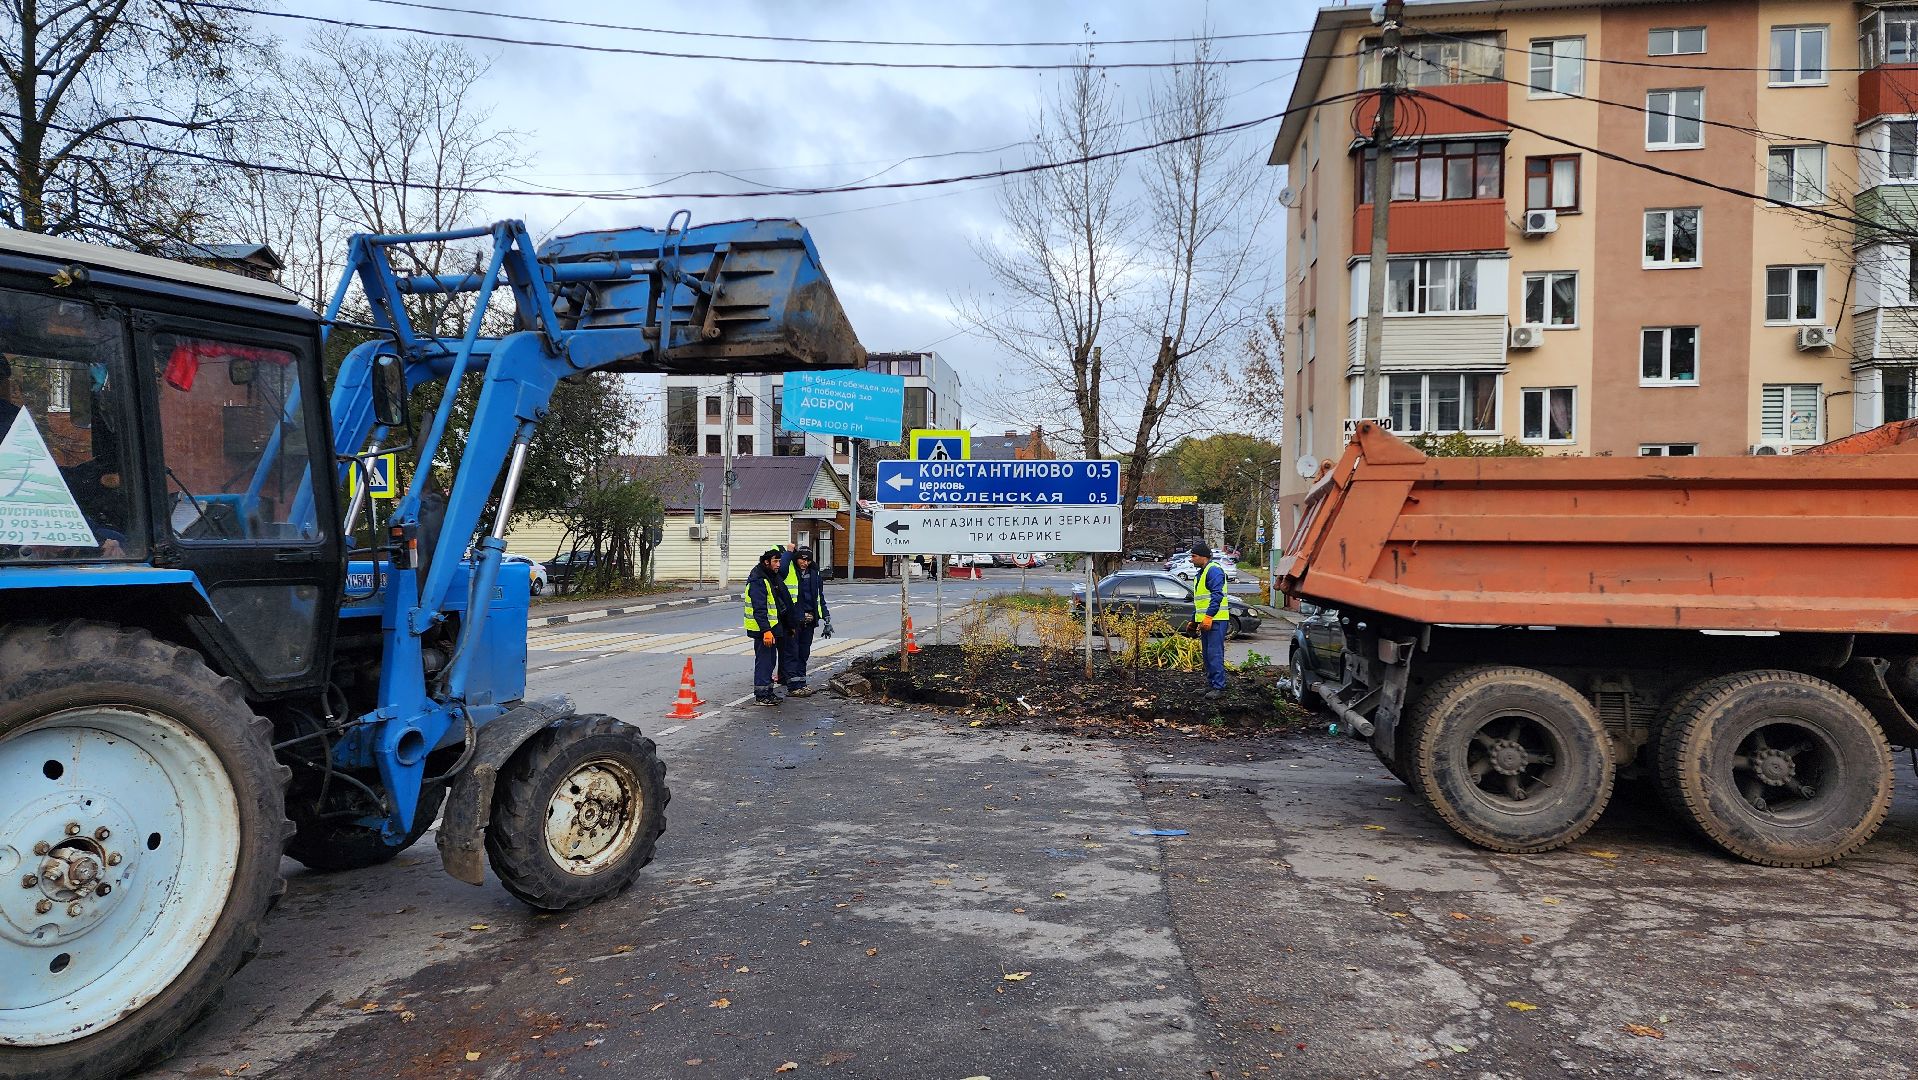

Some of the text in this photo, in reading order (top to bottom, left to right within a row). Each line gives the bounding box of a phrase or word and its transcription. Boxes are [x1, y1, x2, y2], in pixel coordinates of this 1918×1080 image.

[801, 373, 813, 382] Не
[815, 376, 836, 386] будь
[801, 397, 854, 412] ДОБРОМ
[800, 418, 822, 428] ВЕРА
[850, 423, 863, 432] FM
[919, 463, 1111, 479] КОНСТАНТИНОВО 0,5
[919, 481, 965, 492] церковь
[918, 492, 1108, 503] СМОЛЕНСКАЯ 0,5
[11, 519, 85, 529] 903-15-25
[922, 515, 1111, 528] МАГАЗИН СТЕКЛА И ЗЕРКАЛ
[31, 531, 92, 543] 7-40-50
[998, 530, 1062, 541] ФАБРИКЕ
